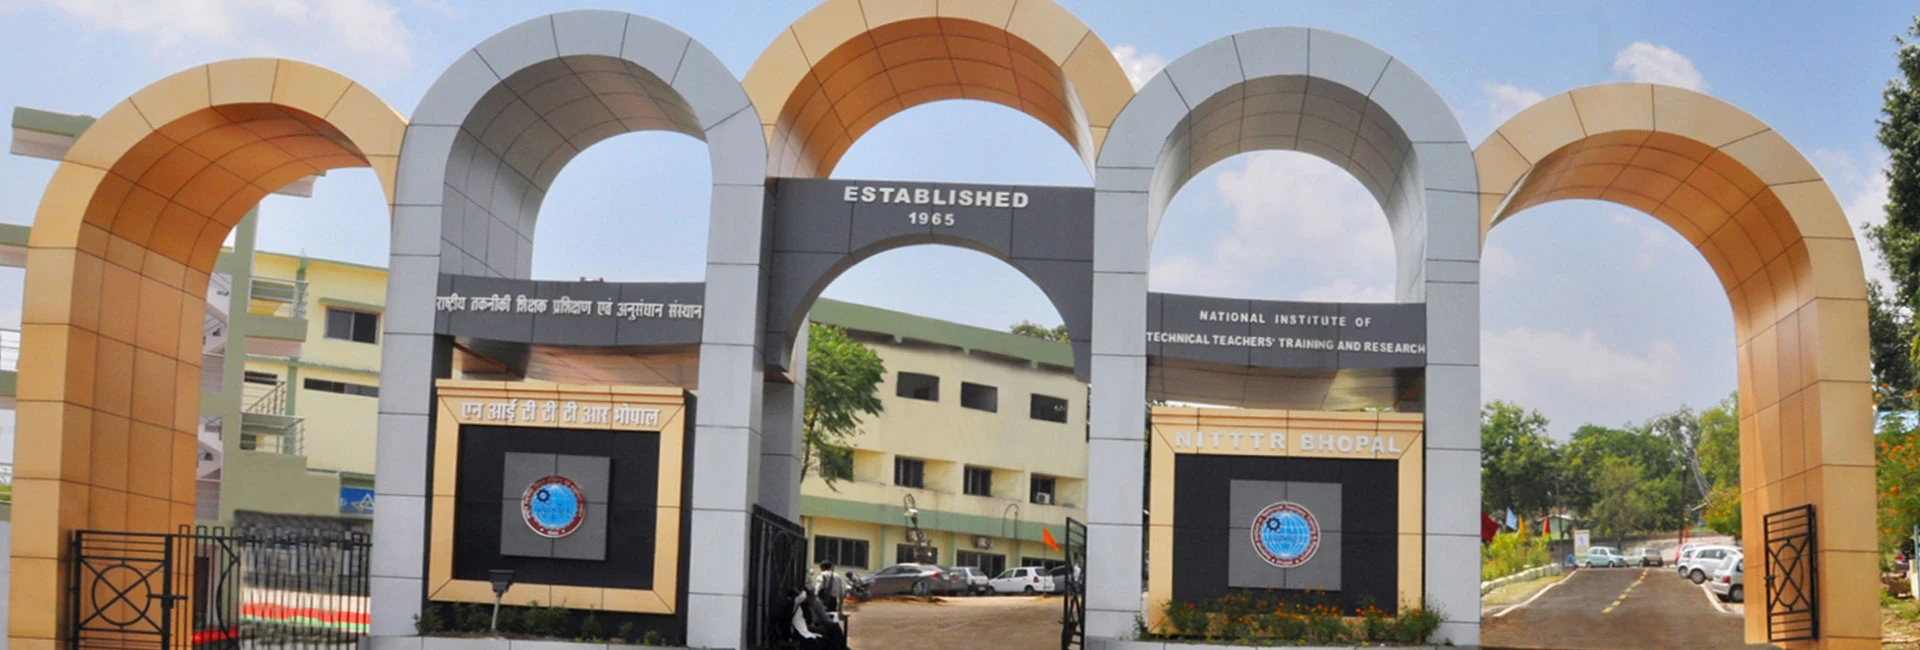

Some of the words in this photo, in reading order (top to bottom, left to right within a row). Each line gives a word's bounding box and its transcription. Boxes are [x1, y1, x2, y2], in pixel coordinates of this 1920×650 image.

[843, 185, 1029, 208] ESTABLISHED
[908, 211, 955, 226] 1965
[470, 293, 511, 313] तकनीकी
[597, 297, 614, 316] एवं
[668, 299, 703, 319] संस्थान
[1199, 310, 1266, 324] NATIONAL
[1275, 314, 1347, 327] INSTITUTE
[1355, 317, 1372, 328] OF
[1146, 332, 1210, 345] TECHNICAL
[1279, 338, 1334, 350] TRAINING
[1337, 340, 1361, 352] AND
[1364, 341, 1426, 354] RESEARCH
[461, 402, 483, 419] एन
[488, 399, 518, 423] आई
[522, 400, 536, 421] टी
[542, 401, 558, 422] टी
[563, 401, 578, 422] टी
[583, 406, 610, 424] आर
[1175, 431, 1286, 450] NITTTR
[1300, 434, 1400, 454] BHOPAL
